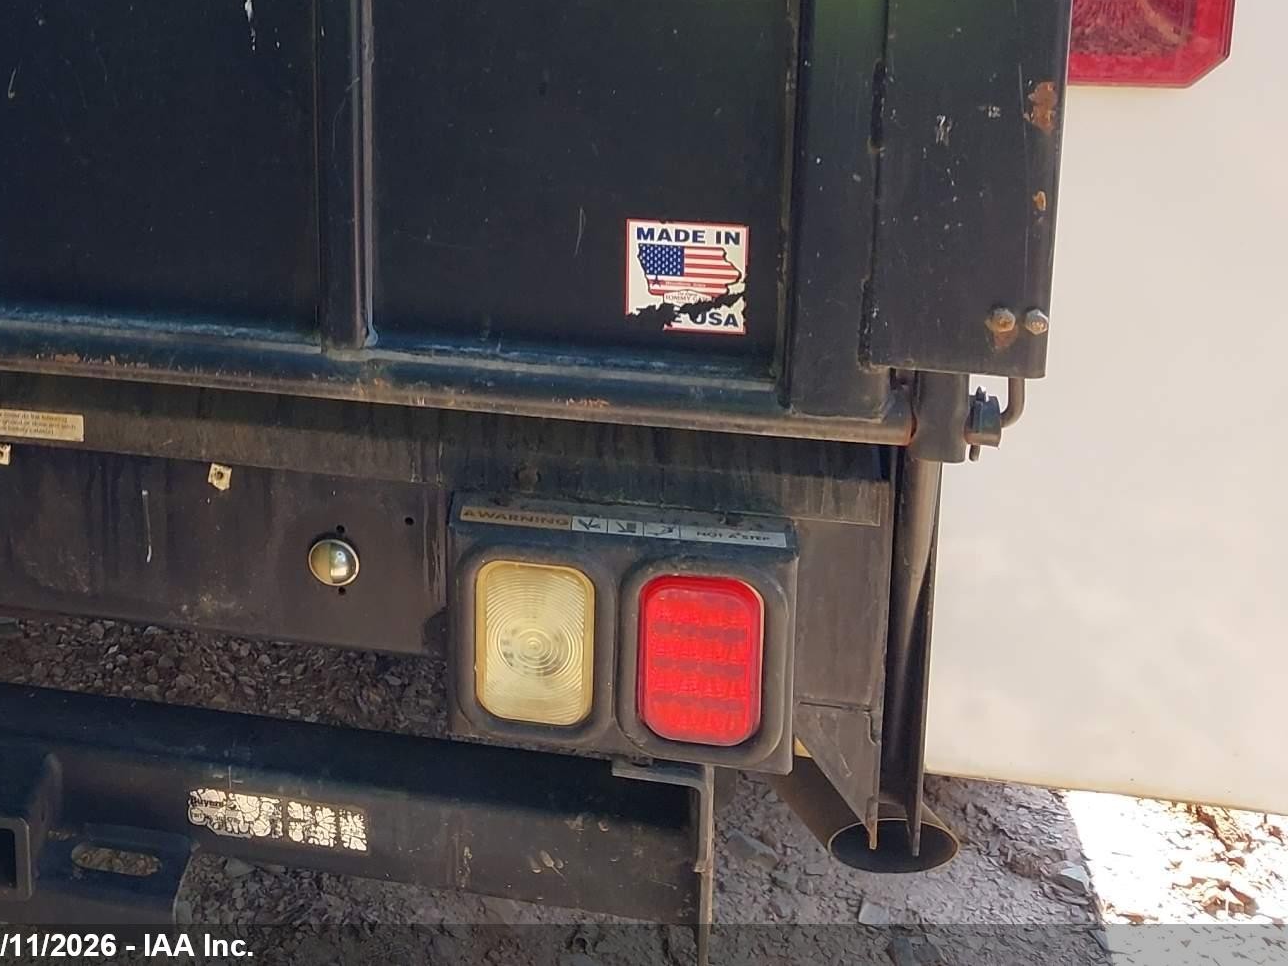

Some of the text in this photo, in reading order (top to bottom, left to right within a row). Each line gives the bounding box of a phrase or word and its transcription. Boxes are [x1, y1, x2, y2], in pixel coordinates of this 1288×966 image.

[636, 226, 740, 245] MADE IN
[477, 510, 569, 526] WARNING
